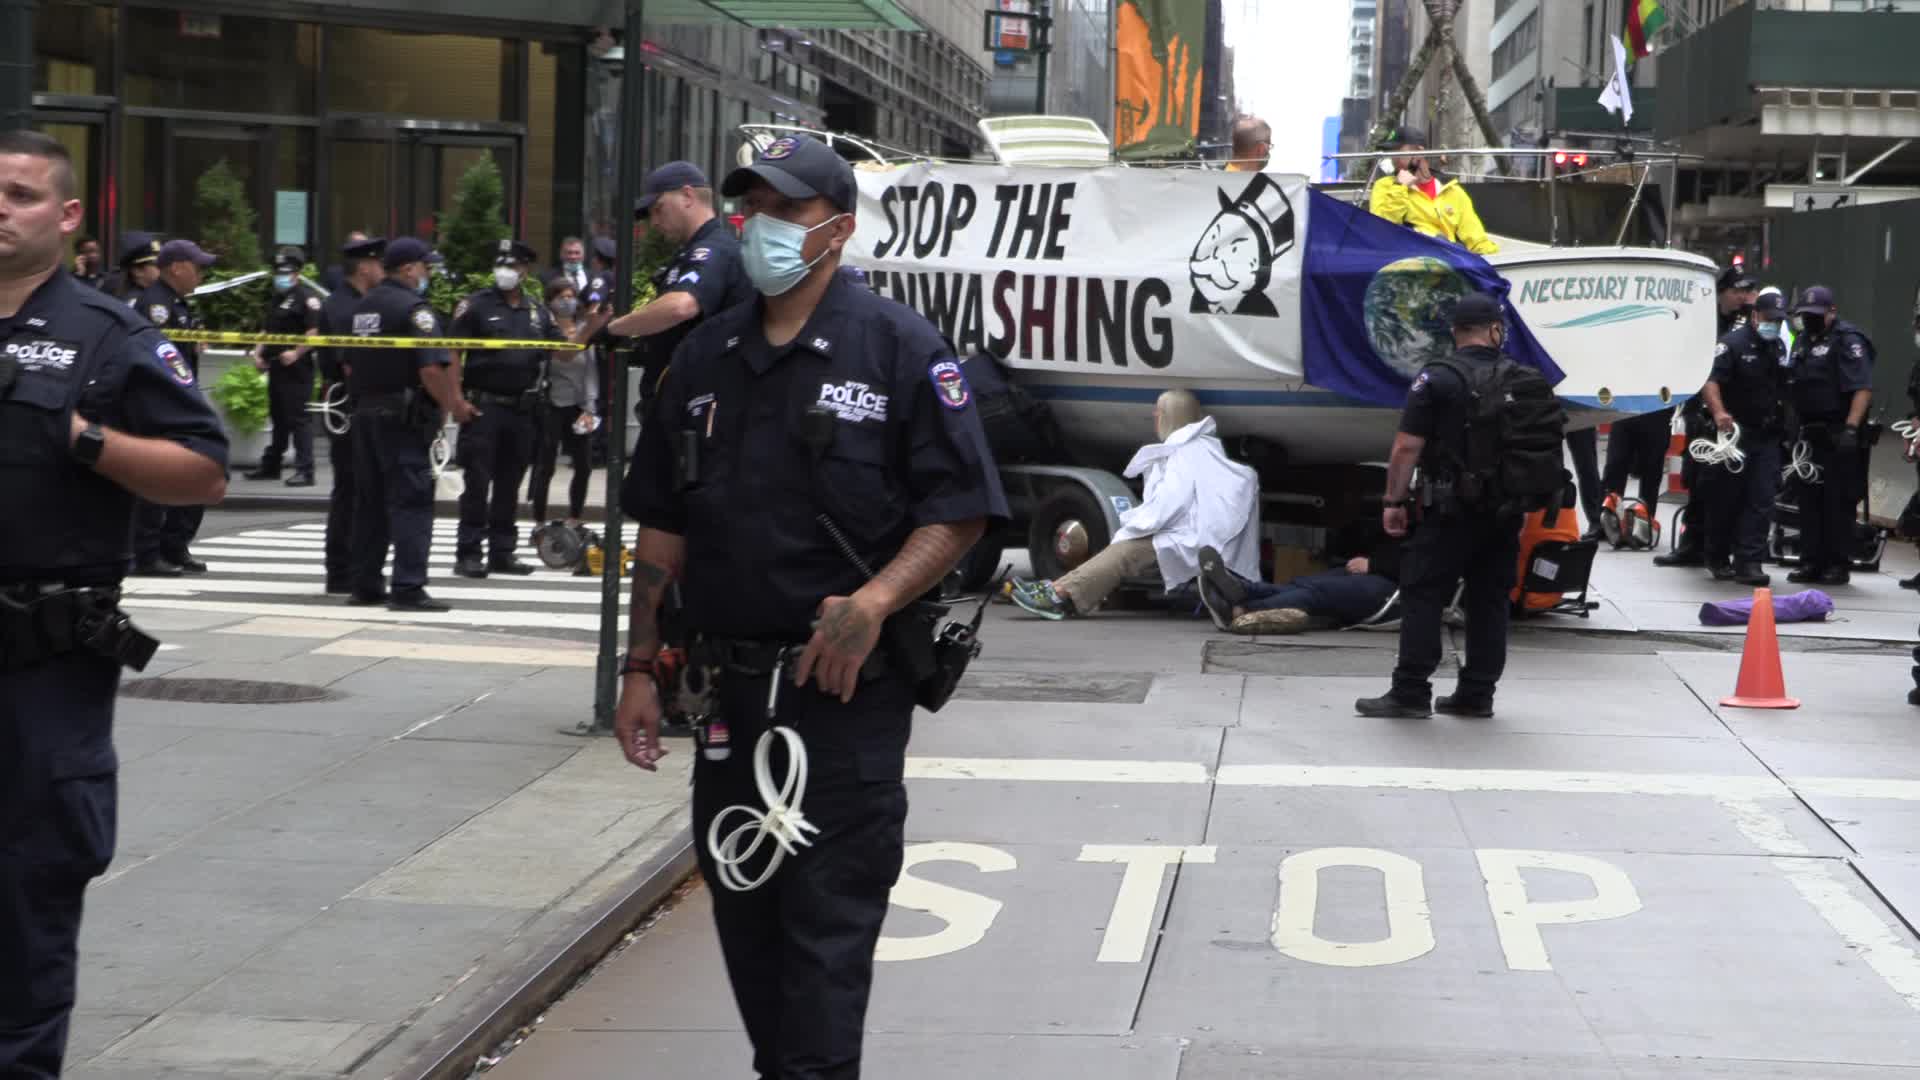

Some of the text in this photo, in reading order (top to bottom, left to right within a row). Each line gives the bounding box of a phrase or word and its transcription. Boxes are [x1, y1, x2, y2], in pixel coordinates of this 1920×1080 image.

[873, 181, 1076, 260] STOP THE
[1520, 276, 1694, 304] NECESSARY TROUBLE
[5, 343, 77, 365] POLICE
[820, 383, 888, 412] POLICE
[874, 842, 1643, 970] STOP
